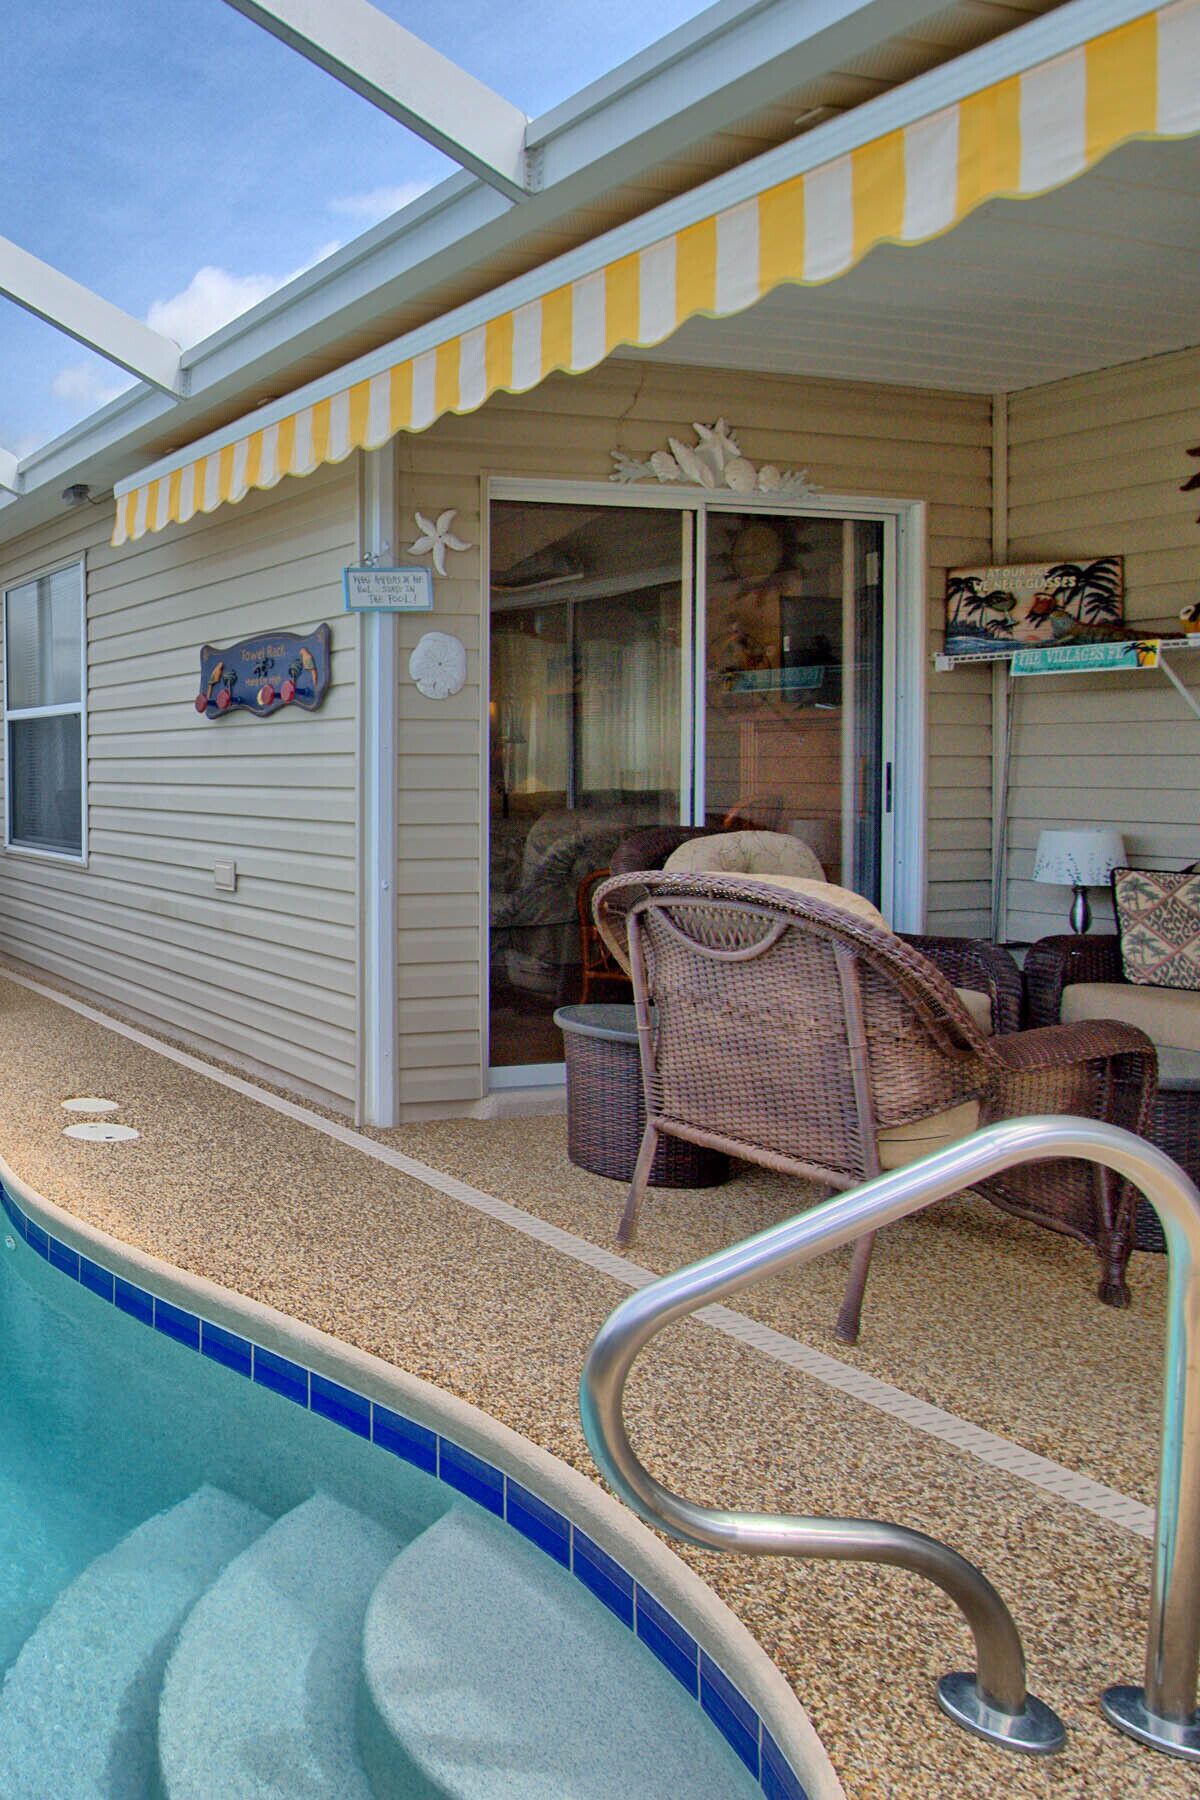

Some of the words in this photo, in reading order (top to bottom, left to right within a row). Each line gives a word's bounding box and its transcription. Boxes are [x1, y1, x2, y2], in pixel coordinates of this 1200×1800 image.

[1003, 567, 1025, 577] OUR
[972, 580, 988, 592] WE
[994, 578, 1022, 590] NEED
[1026, 575, 1077, 589] GLASSES
[1019, 651, 1041, 666] THE
[1047, 646, 1104, 663] VILLAGES
